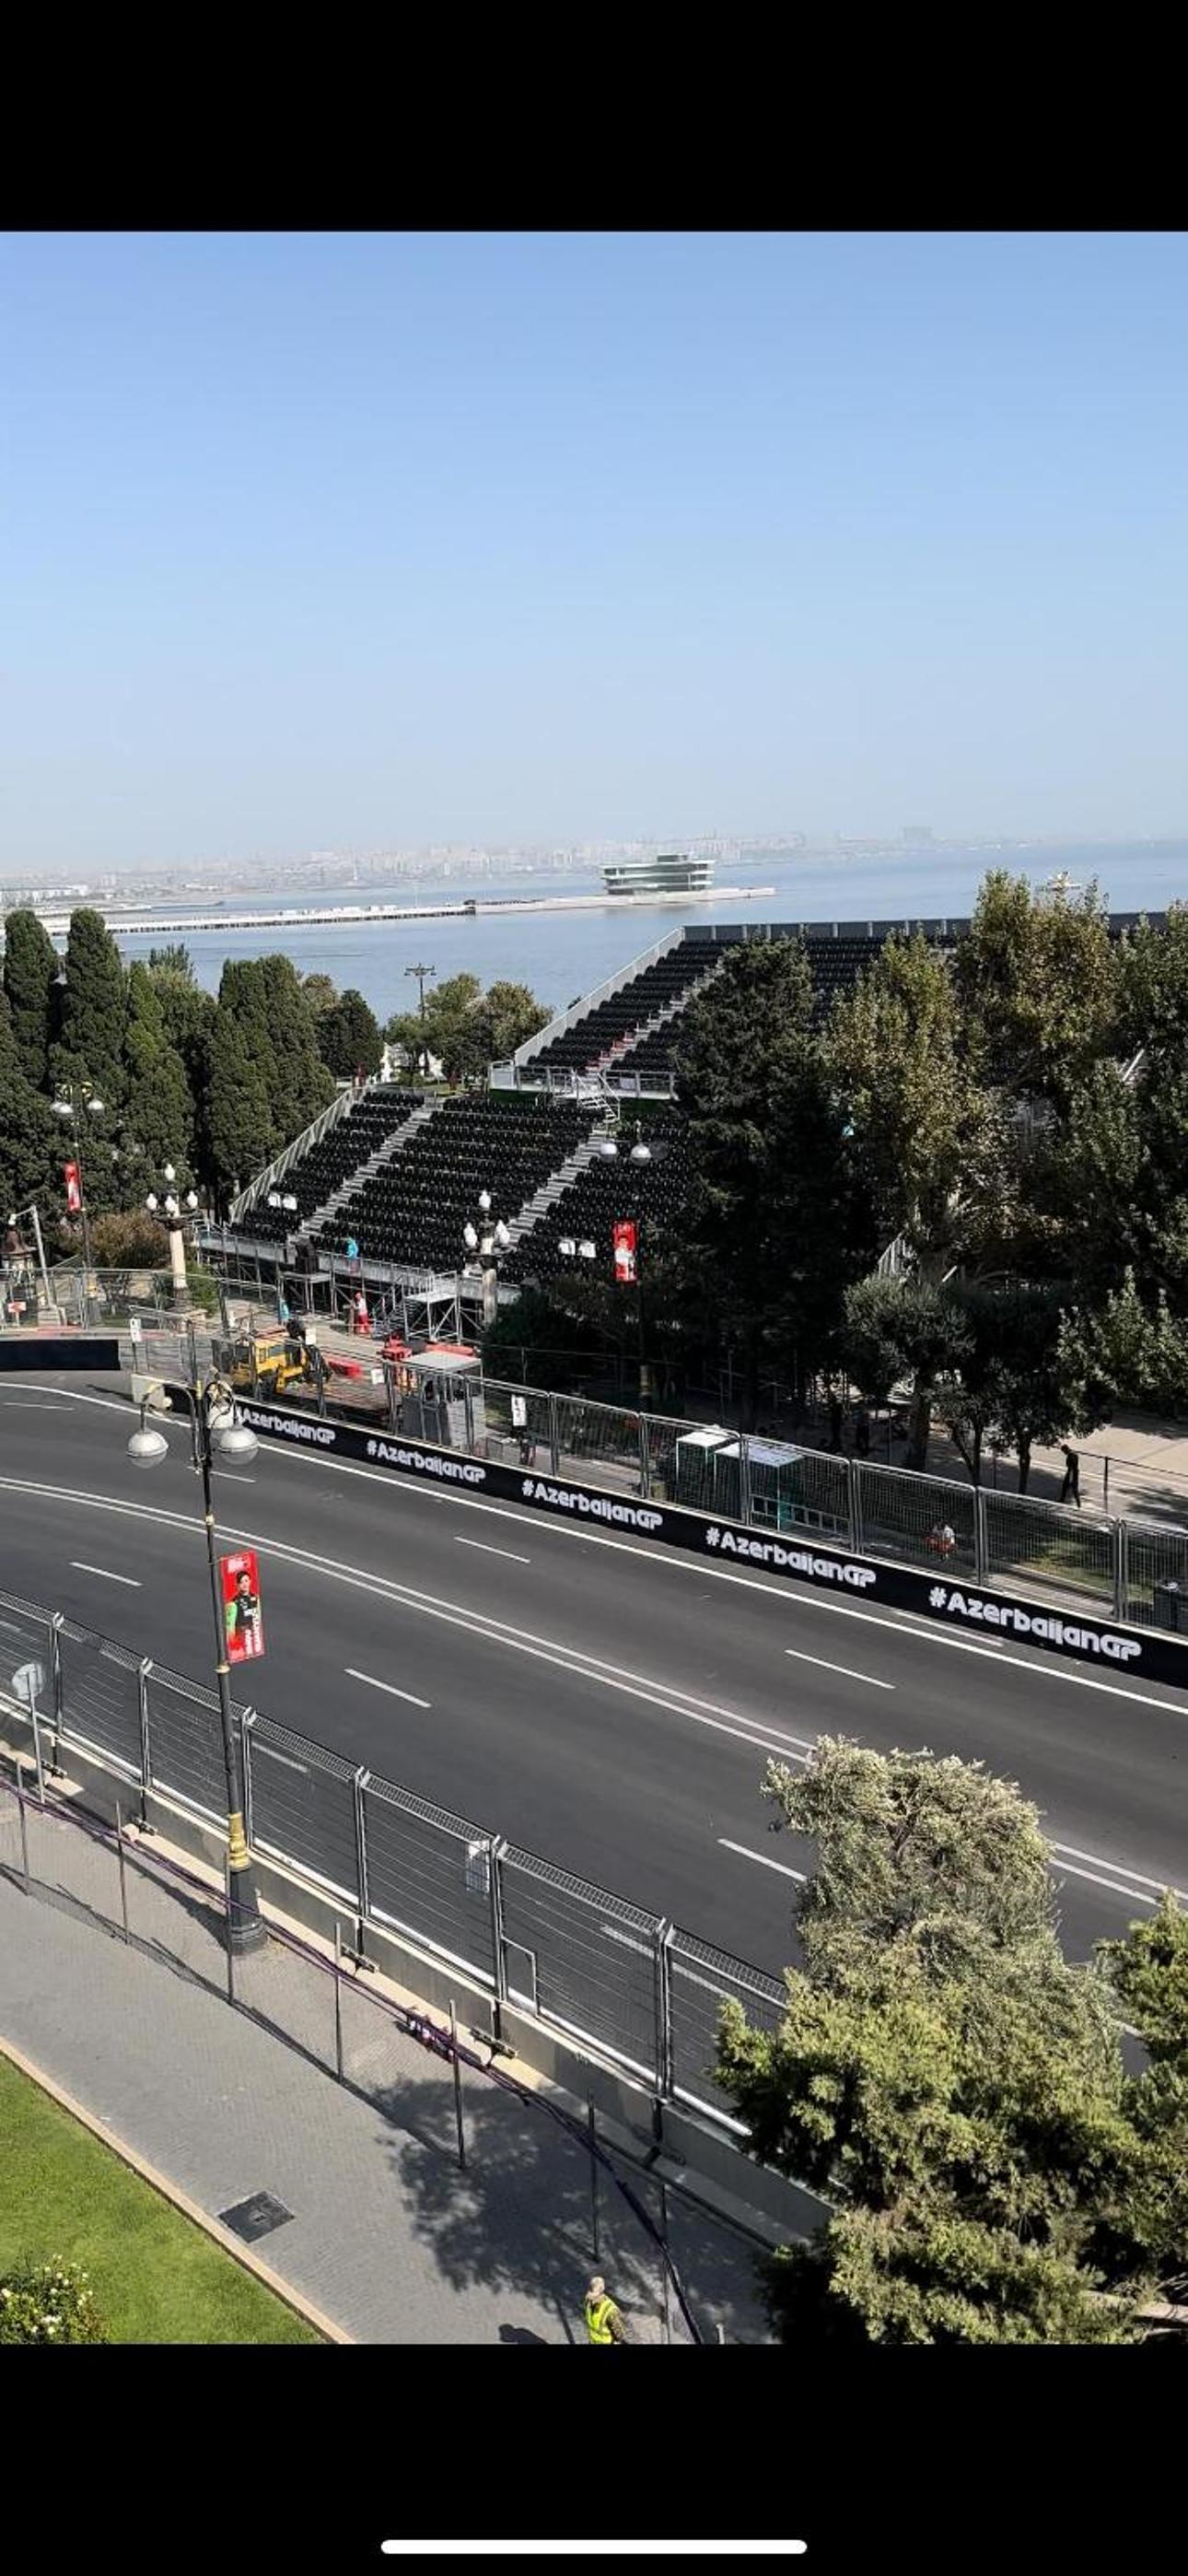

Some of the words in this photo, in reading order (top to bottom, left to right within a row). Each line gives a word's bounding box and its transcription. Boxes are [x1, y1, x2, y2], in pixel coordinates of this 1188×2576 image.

[367, 1440, 486, 1482] #AzerbaijanGP
[521, 1479, 663, 1530] #AzerbaijanGP
[705, 1527, 877, 1587] #AzerbaijanGP
[928, 1587, 1143, 1660] #AzerbaijanGP
